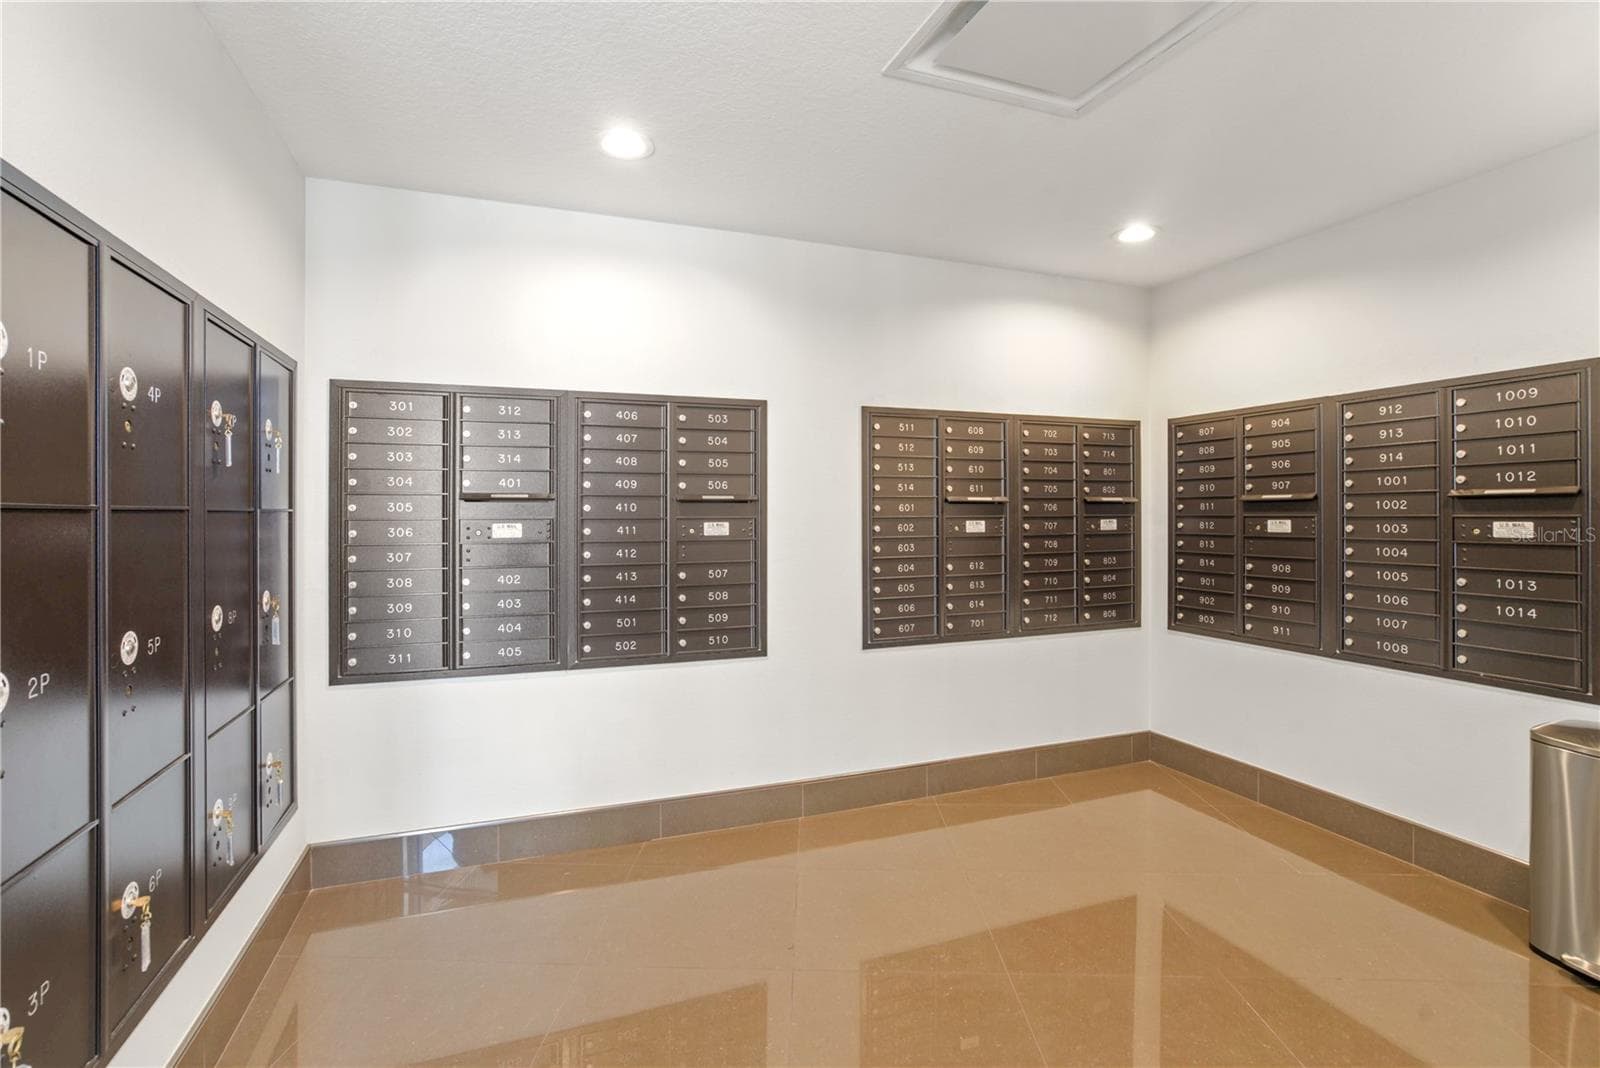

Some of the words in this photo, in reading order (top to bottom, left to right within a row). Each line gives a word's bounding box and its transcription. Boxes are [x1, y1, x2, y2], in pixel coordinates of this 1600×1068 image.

[27, 346, 48, 370] 1P
[147, 385, 162, 403] 4P
[1496, 387, 1538, 402] 1009
[389, 400, 413, 412] 301
[498, 405, 521, 416] 312
[1378, 403, 1403, 416] 912
[615, 410, 638, 421] 406
[707, 413, 729, 424] 503
[898, 422, 914, 432] 511
[1271, 417, 1290, 429] 904
[1495, 415, 1537, 429] 1010
[387, 426, 413, 437] 302
[497, 429, 521, 440] 313
[967, 426, 984, 435] 608
[1043, 429, 1058, 438] 702
[1198, 426, 1215, 437] 807
[1379, 427, 1404, 439] 913
[615, 433, 638, 444] 407
[707, 436, 728, 446] 504
[1102, 432, 1116, 441] 713
[898, 442, 915, 452] 512
[1271, 438, 1291, 449] 905
[967, 445, 984, 454] 609
[1044, 447, 1058, 456] 703
[1102, 450, 1116, 458] 714
[1198, 445, 1215, 455] 808
[1497, 443, 1536, 456] 1011
[387, 451, 413, 463] 303
[497, 453, 521, 464] 314
[615, 456, 638, 466] 408
[1379, 451, 1404, 463] 914
[708, 458, 729, 468] 505
[897, 462, 915, 472] 513
[1271, 459, 1291, 469] 906
[968, 464, 985, 474] 610
[1043, 466, 1058, 475] 704
[1199, 464, 1216, 474] 809
[387, 476, 413, 487] 304
[1377, 475, 1407, 486] 1001
[1495, 470, 1537, 483] 1012
[498, 478, 521, 488] 401
[615, 479, 638, 489] 409
[707, 480, 729, 490] 506
[897, 483, 914, 492] 514
[969, 484, 984, 493] 611
[1043, 484, 1058, 493] 705
[1199, 483, 1216, 492] 810
[1271, 480, 1291, 490] 907
[387, 502, 414, 513] 305
[615, 502, 637, 512] 410
[898, 503, 915, 512] 601
[1043, 503, 1058, 512] 706
[1199, 502, 1214, 511] 811
[1375, 499, 1408, 510] 1002
[616, 525, 636, 535] 411
[897, 522, 914, 533] 602
[1044, 521, 1058, 530] 707
[1199, 521, 1215, 530] 812
[1376, 523, 1409, 534] 1003
[387, 527, 414, 538] 306
[897, 543, 915, 553] 603
[1199, 539, 1215, 549] 813
[386, 552, 413, 563] 307
[615, 548, 637, 559] 412
[1375, 547, 1408, 558] 1004
[897, 563, 915, 573] 604
[969, 561, 985, 570] 612
[1044, 558, 1058, 567] 709
[1199, 558, 1215, 567] 814
[708, 568, 728, 579] 507
[1271, 563, 1291, 574] 908
[497, 574, 521, 585] 402
[615, 571, 638, 582] 413
[1043, 576, 1058, 585] 710
[1102, 574, 1117, 583] 804
[1199, 577, 1215, 586] 901
[1376, 570, 1409, 582] 1005
[386, 577, 413, 589] 308
[897, 583, 915, 593] 605
[969, 580, 985, 590] 613
[1271, 583, 1291, 594] 909
[1496, 578, 1537, 592] 1013
[615, 594, 636, 604] 414
[708, 591, 729, 601] 508
[1044, 595, 1058, 604] 711
[1199, 596, 1215, 606] 902
[1376, 594, 1409, 606] 1006
[386, 602, 413, 614] 309
[497, 598, 522, 609] 403
[897, 603, 916, 613] 606
[968, 599, 985, 609] 614
[1271, 604, 1291, 615] 910
[1496, 605, 1538, 619] 1014
[616, 617, 636, 628] 501
[708, 612, 729, 623] 509
[1043, 613, 1058, 622] 712
[1198, 614, 1215, 625] 903
[497, 623, 522, 633] 404
[898, 623, 915, 633] 607
[970, 619, 985, 628] 701
[1376, 617, 1408, 630] 1007
[386, 627, 413, 639] 310
[1272, 625, 1290, 636] 911
[615, 640, 637, 651] 502
[708, 634, 729, 646] 510
[147, 636, 161, 656] 5P
[497, 646, 522, 657] 405
[1376, 640, 1409, 655] 1008
[388, 653, 411, 664] 311
[27, 672, 50, 700] 2P
[148, 867, 163, 893] 6P
[27, 979, 50, 1017] 3P
